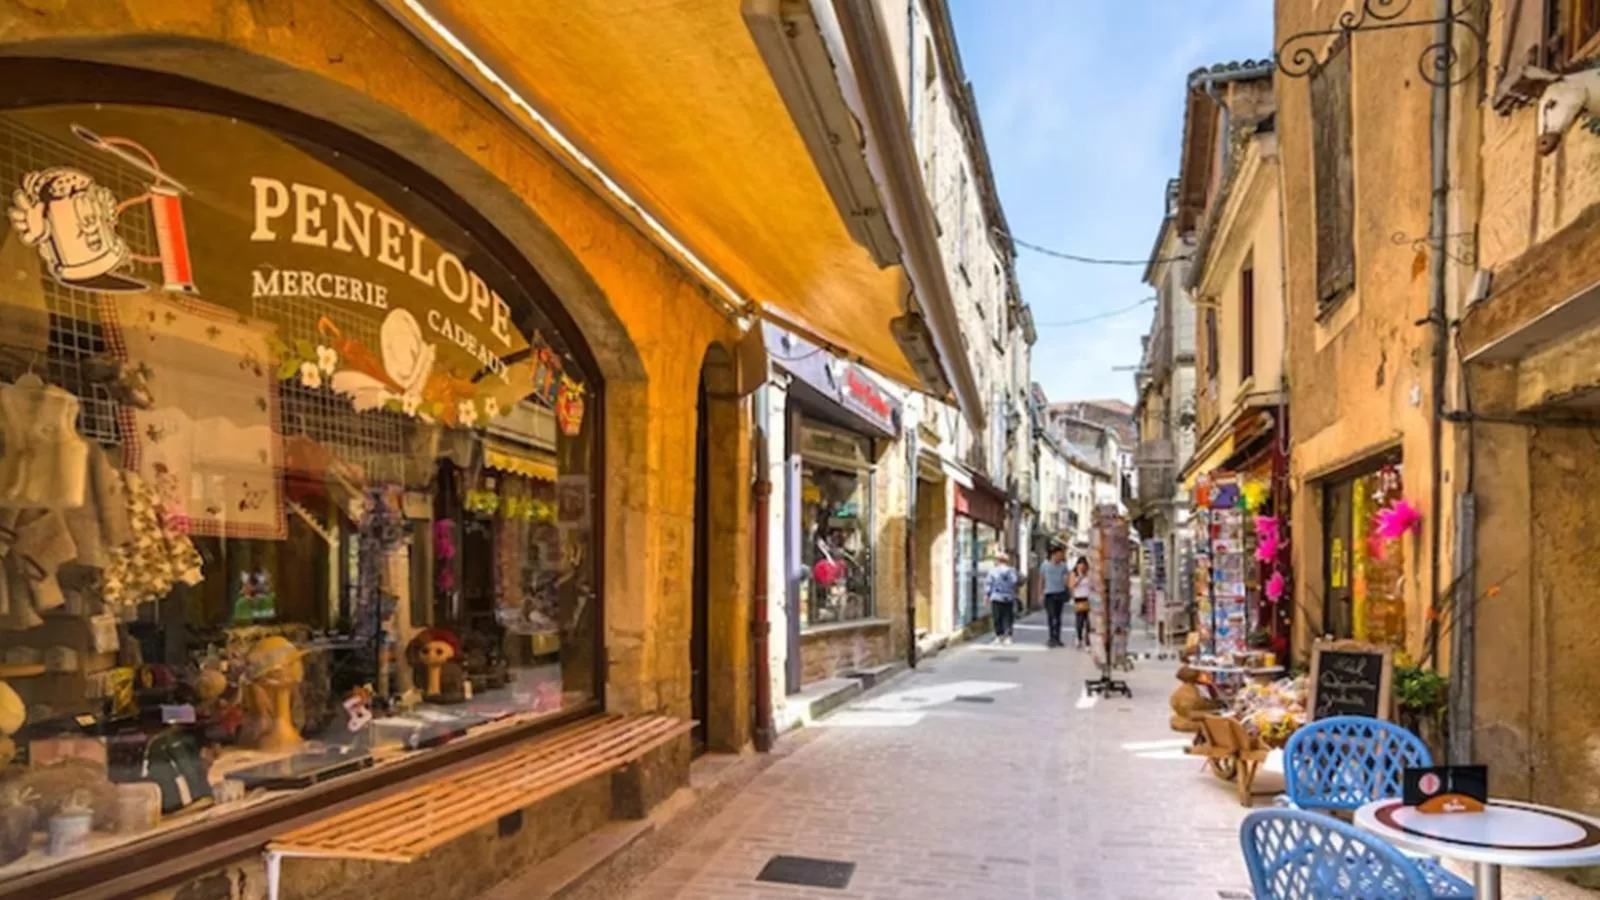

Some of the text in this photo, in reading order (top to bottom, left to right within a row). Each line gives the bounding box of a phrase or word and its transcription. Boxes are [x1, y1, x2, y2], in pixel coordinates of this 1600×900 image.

[250, 176, 512, 348] PENELOPE
[252, 269, 389, 309] MERCERIE
[427, 309, 510, 385] CADEAUX
